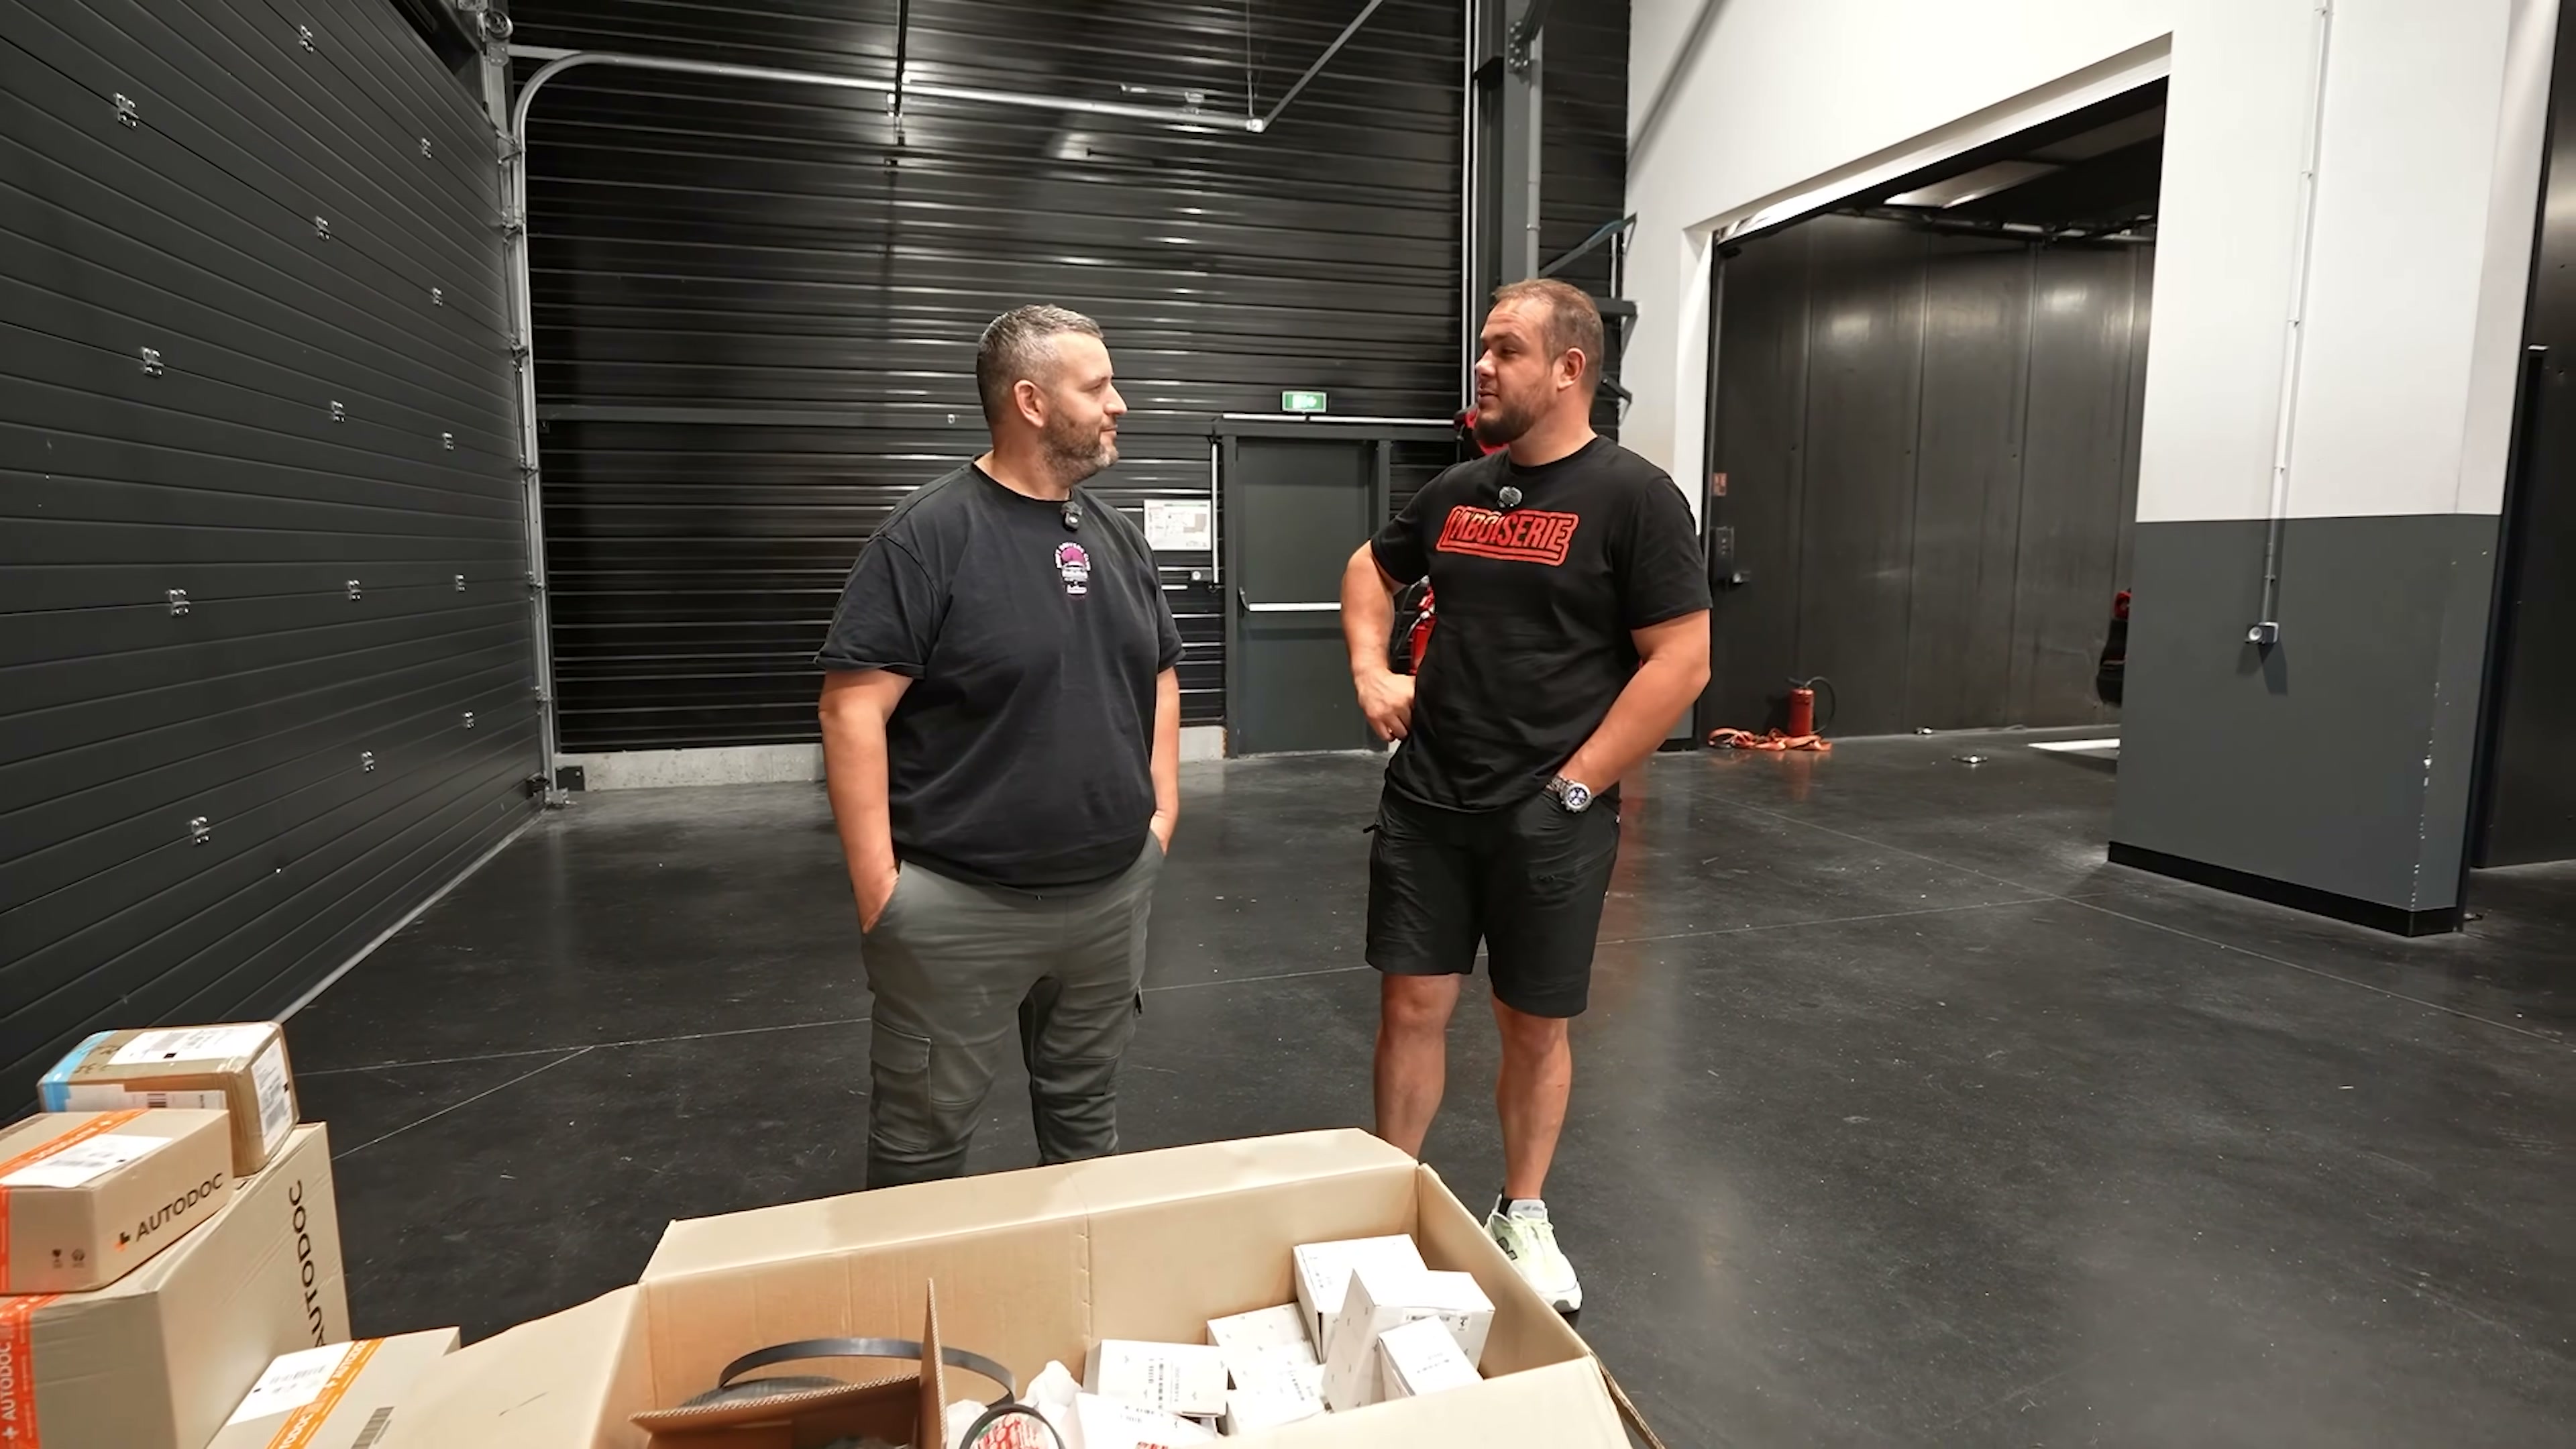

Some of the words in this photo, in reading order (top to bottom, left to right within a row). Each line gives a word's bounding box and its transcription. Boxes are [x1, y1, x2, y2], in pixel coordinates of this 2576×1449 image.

[136, 1172, 223, 1242] AUTODOC
[0, 1341, 17, 1421] AUTODOC
[278, 1412, 315, 1449] TODOC
